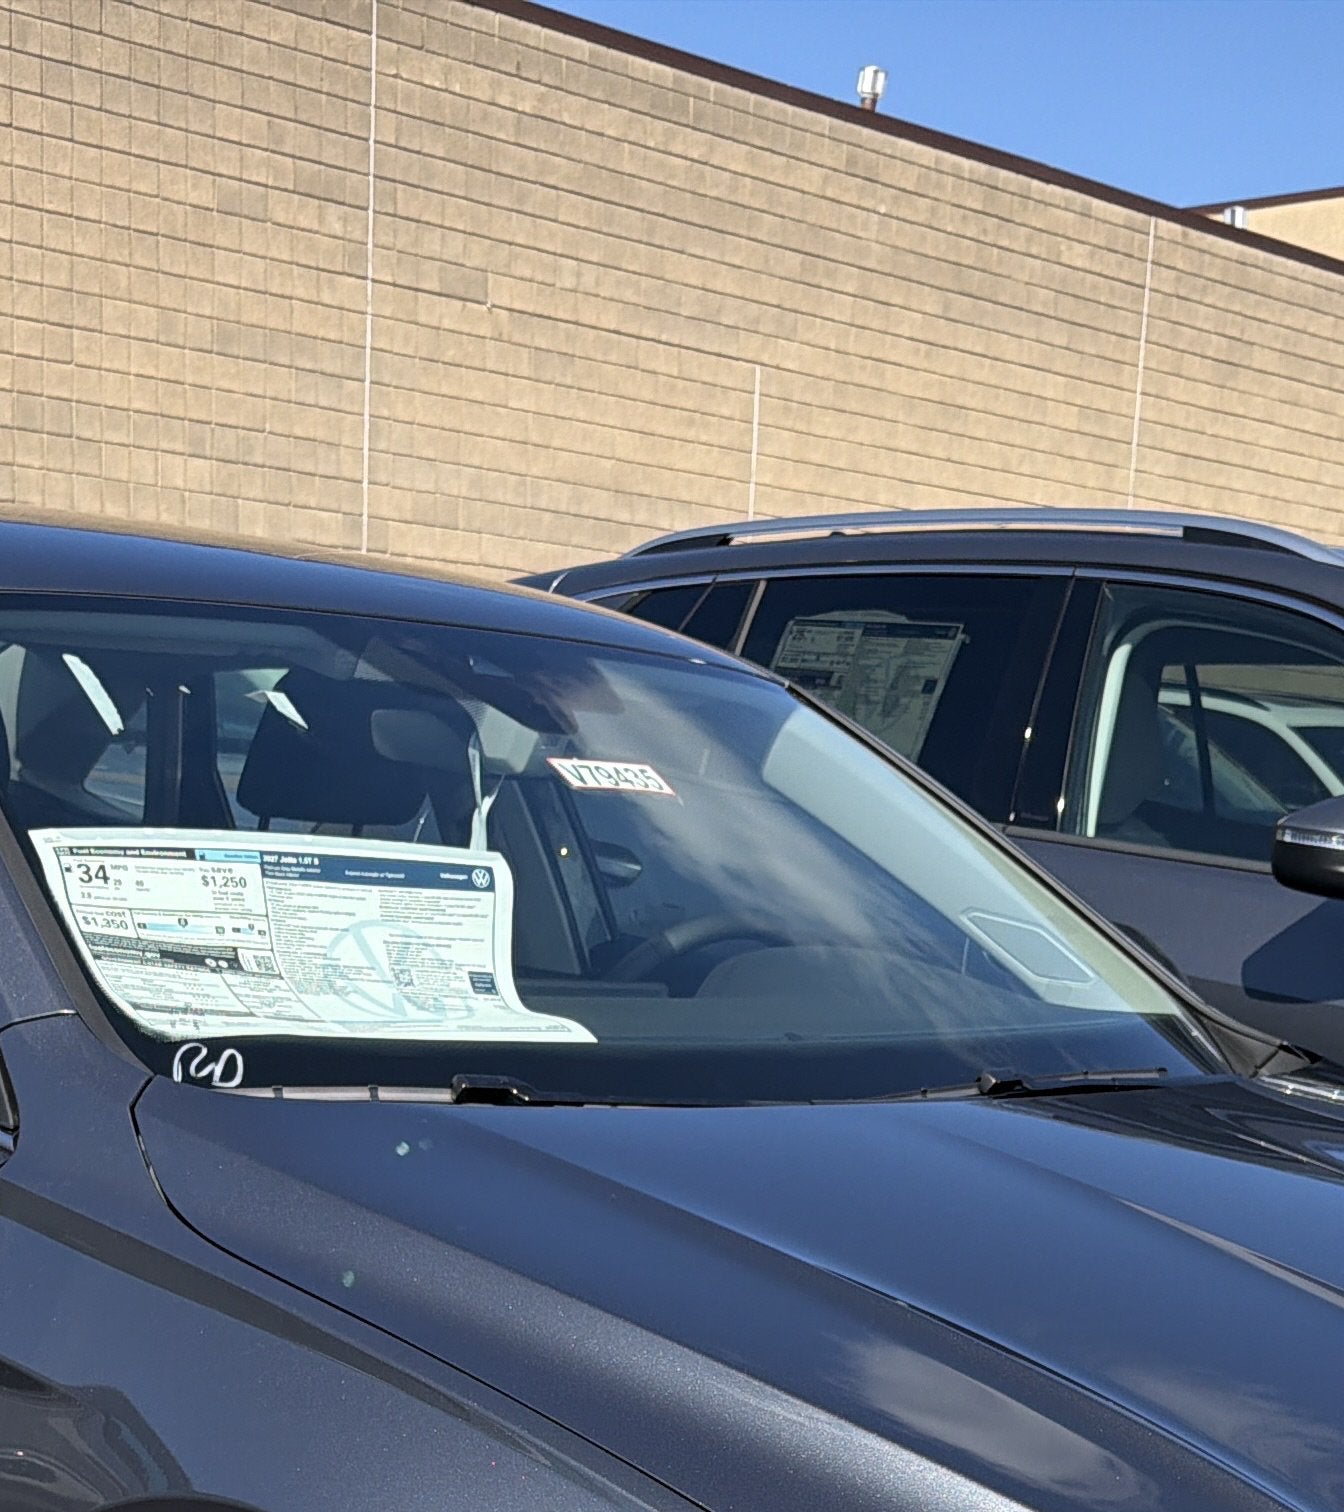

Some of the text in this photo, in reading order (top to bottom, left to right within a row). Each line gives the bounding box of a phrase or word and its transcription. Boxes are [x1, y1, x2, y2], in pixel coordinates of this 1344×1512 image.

[558, 763, 664, 792] V79435
[76, 863, 111, 885] 34
[201, 875, 247, 889] $1,250
[82, 915, 128, 930] $1,350
